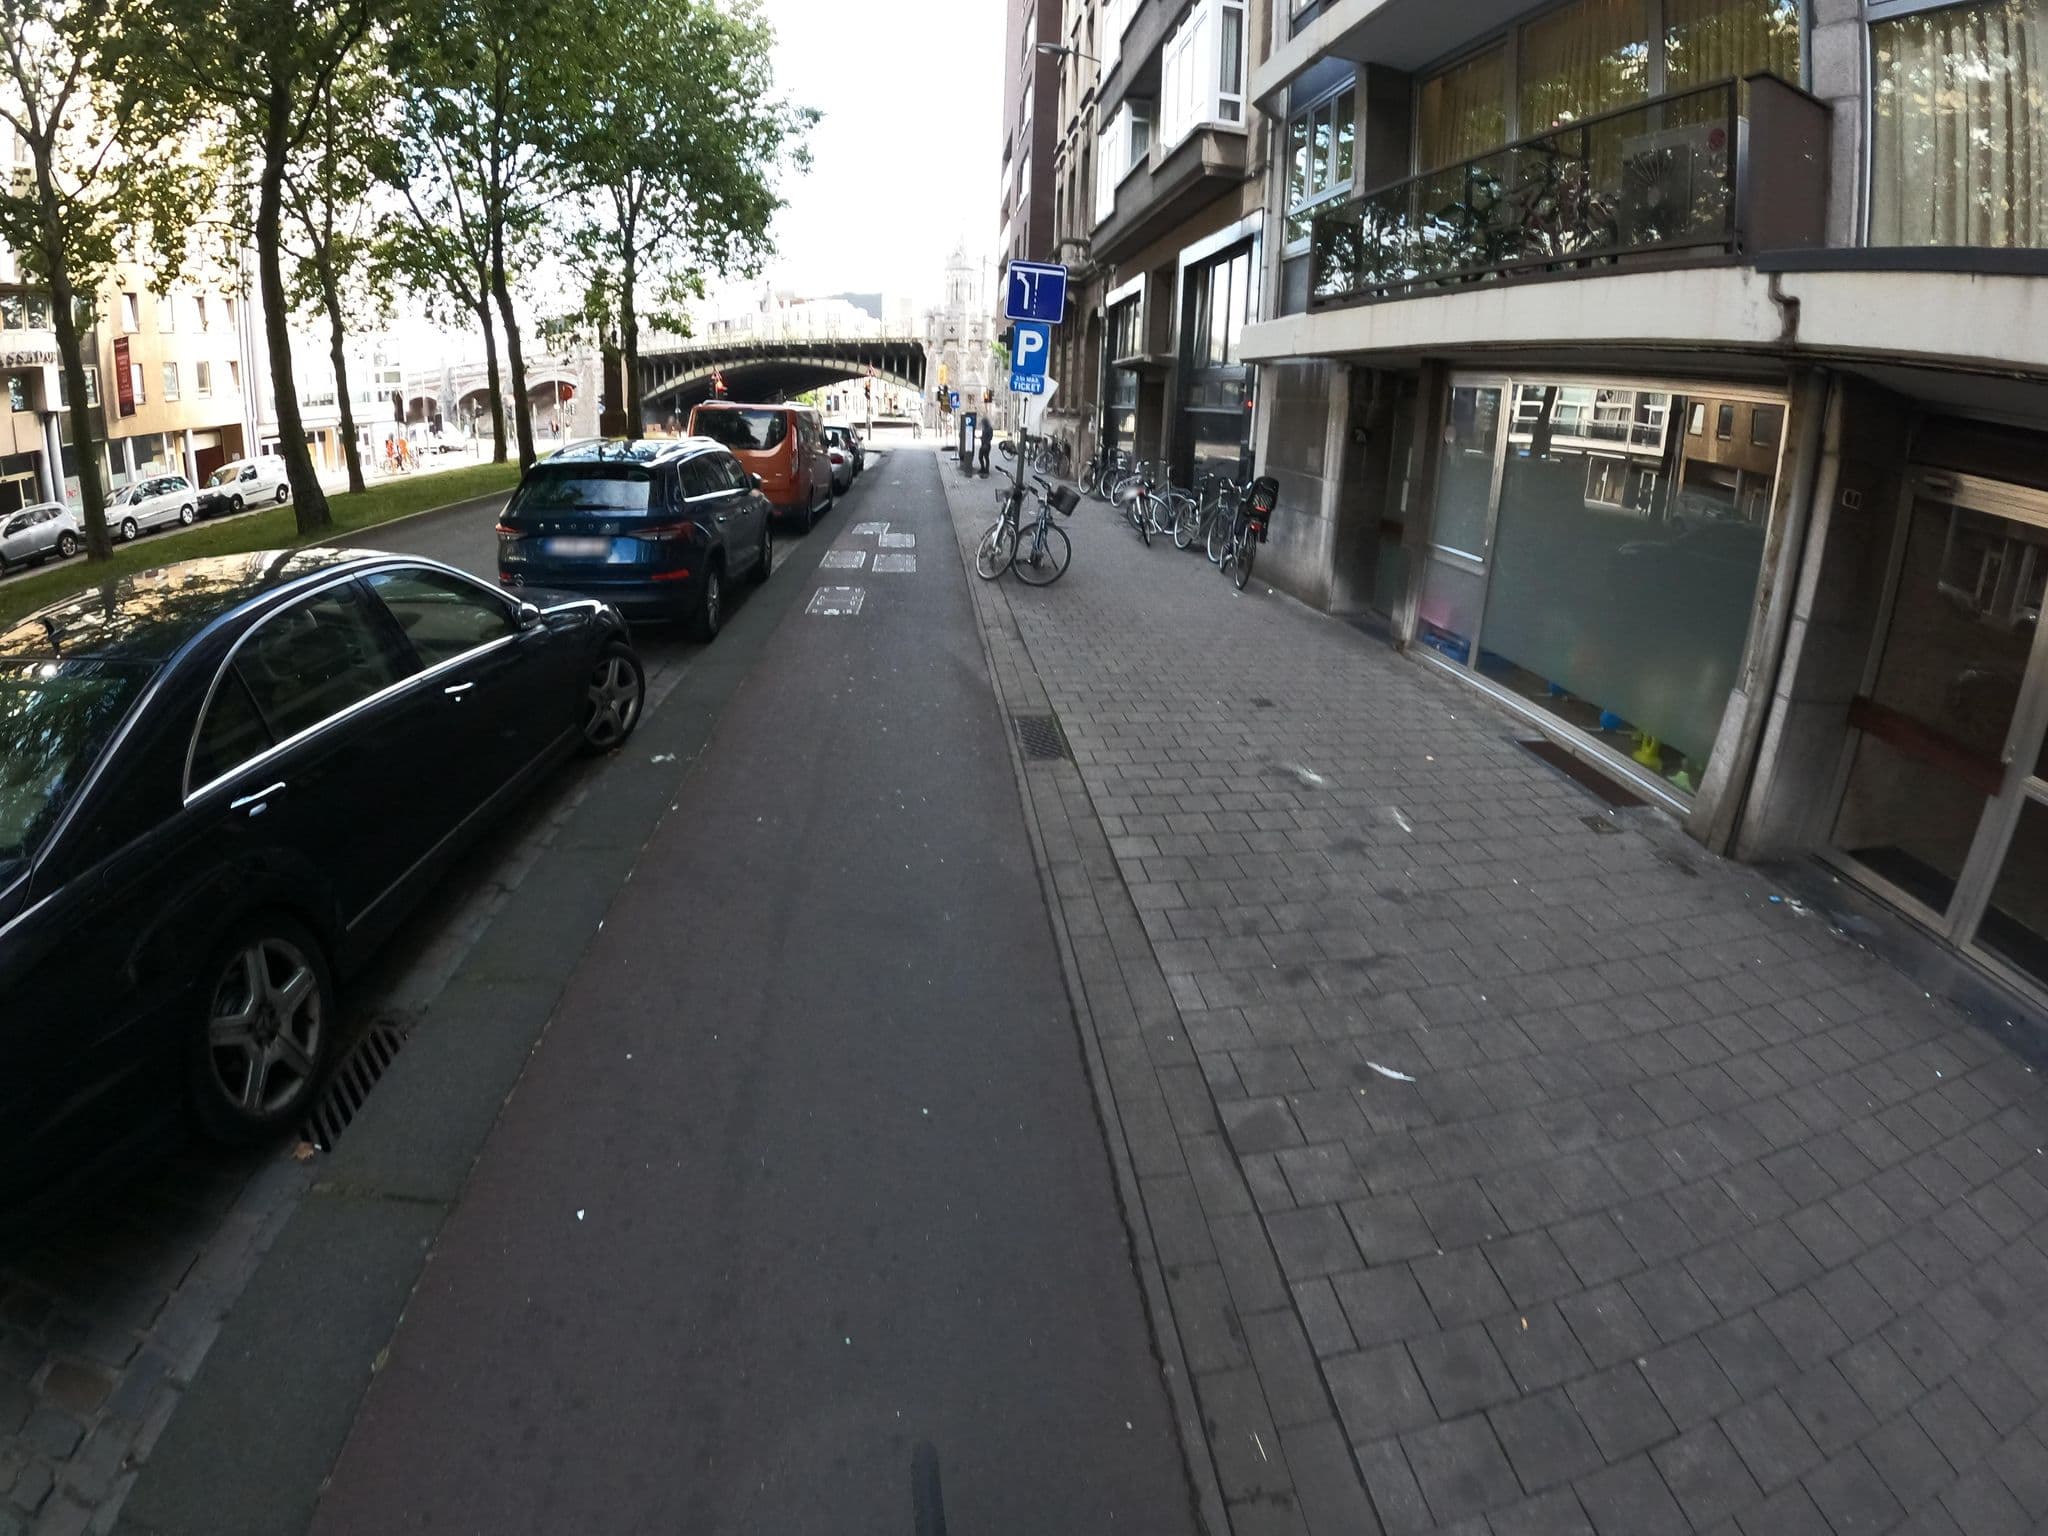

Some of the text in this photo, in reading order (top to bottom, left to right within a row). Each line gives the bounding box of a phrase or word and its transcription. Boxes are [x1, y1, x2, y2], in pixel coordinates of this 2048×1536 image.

[1017, 330, 1043, 366] P
[1013, 381, 1041, 392] TICKET
[965, 417, 971, 425] P
